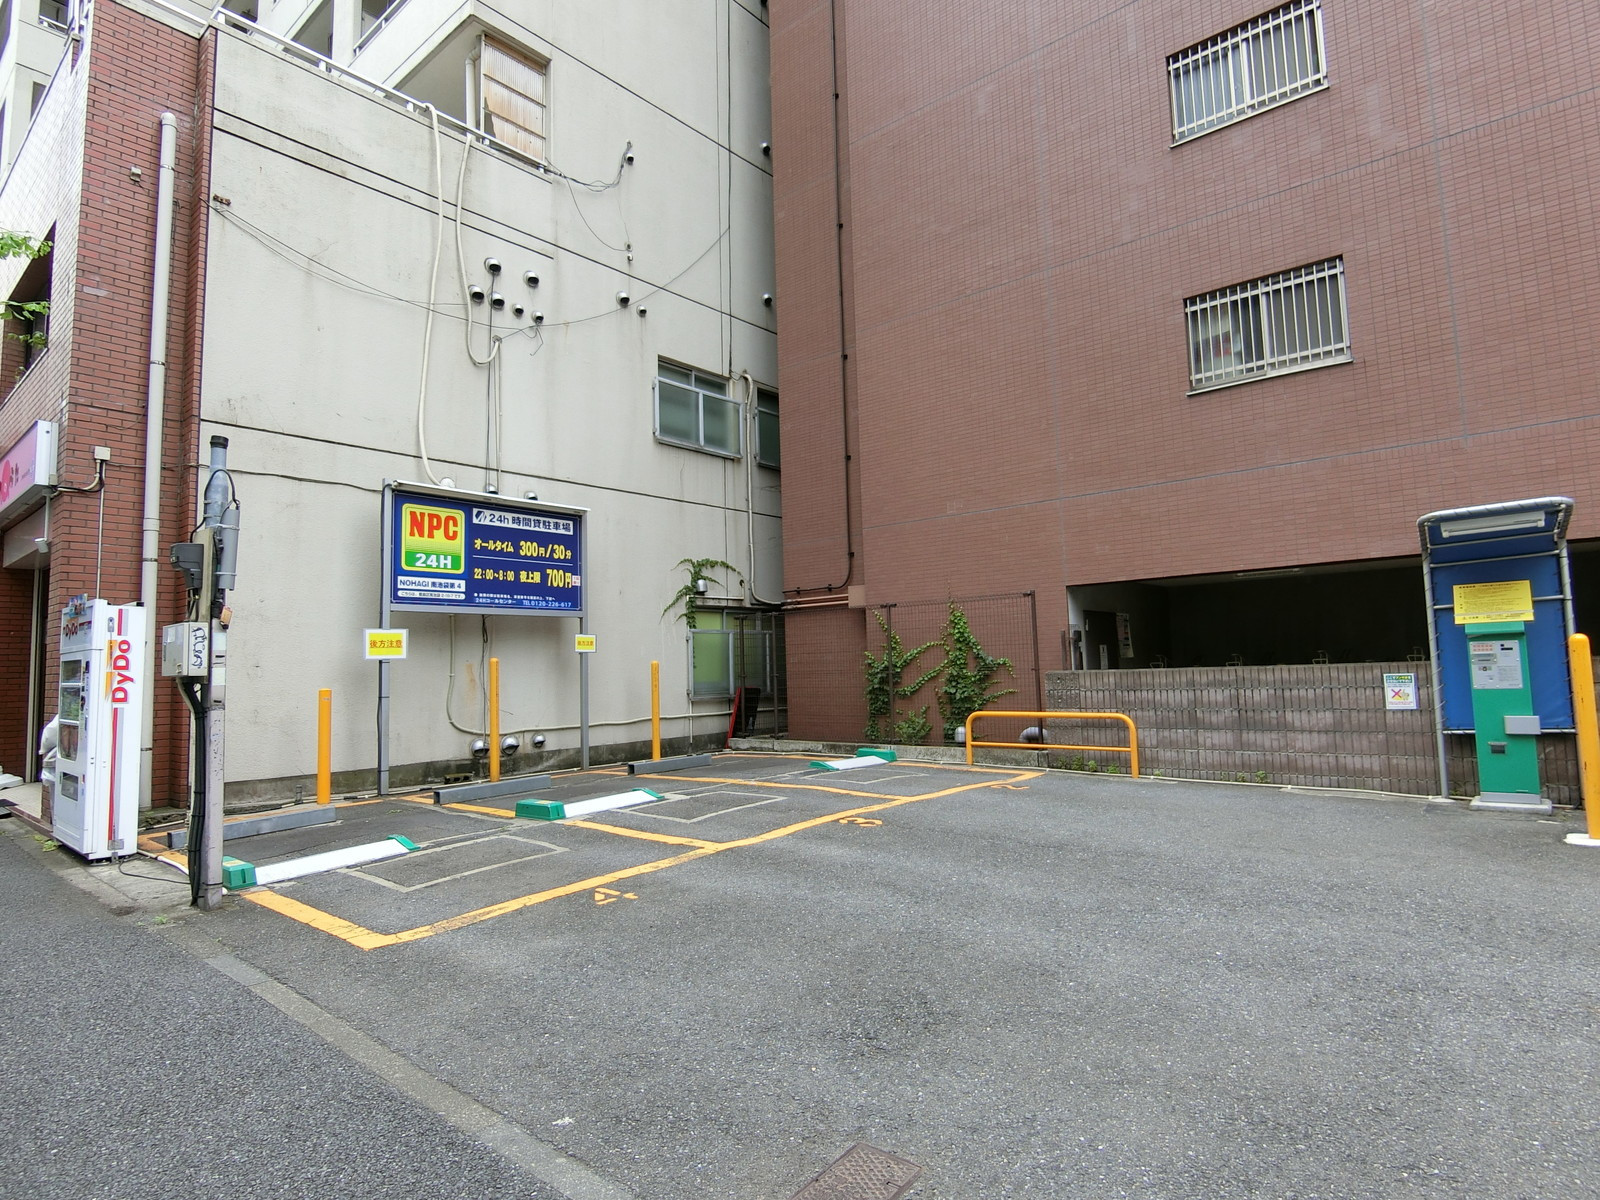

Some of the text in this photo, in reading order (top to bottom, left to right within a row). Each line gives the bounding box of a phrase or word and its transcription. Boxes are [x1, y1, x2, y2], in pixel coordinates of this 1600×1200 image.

[409, 510, 459, 541] NPC
[489, 513, 571, 533] 24h 時間貸駐車場
[474, 538, 514, 553] オールタイム
[415, 553, 452, 569] 24H
[399, 579, 429, 588] NOHAGI
[519, 571, 541, 584] 夜上限
[546, 568, 572, 588] 700円
[369, 639, 404, 648] 後方注意
[112, 639, 134, 703] DyDo
